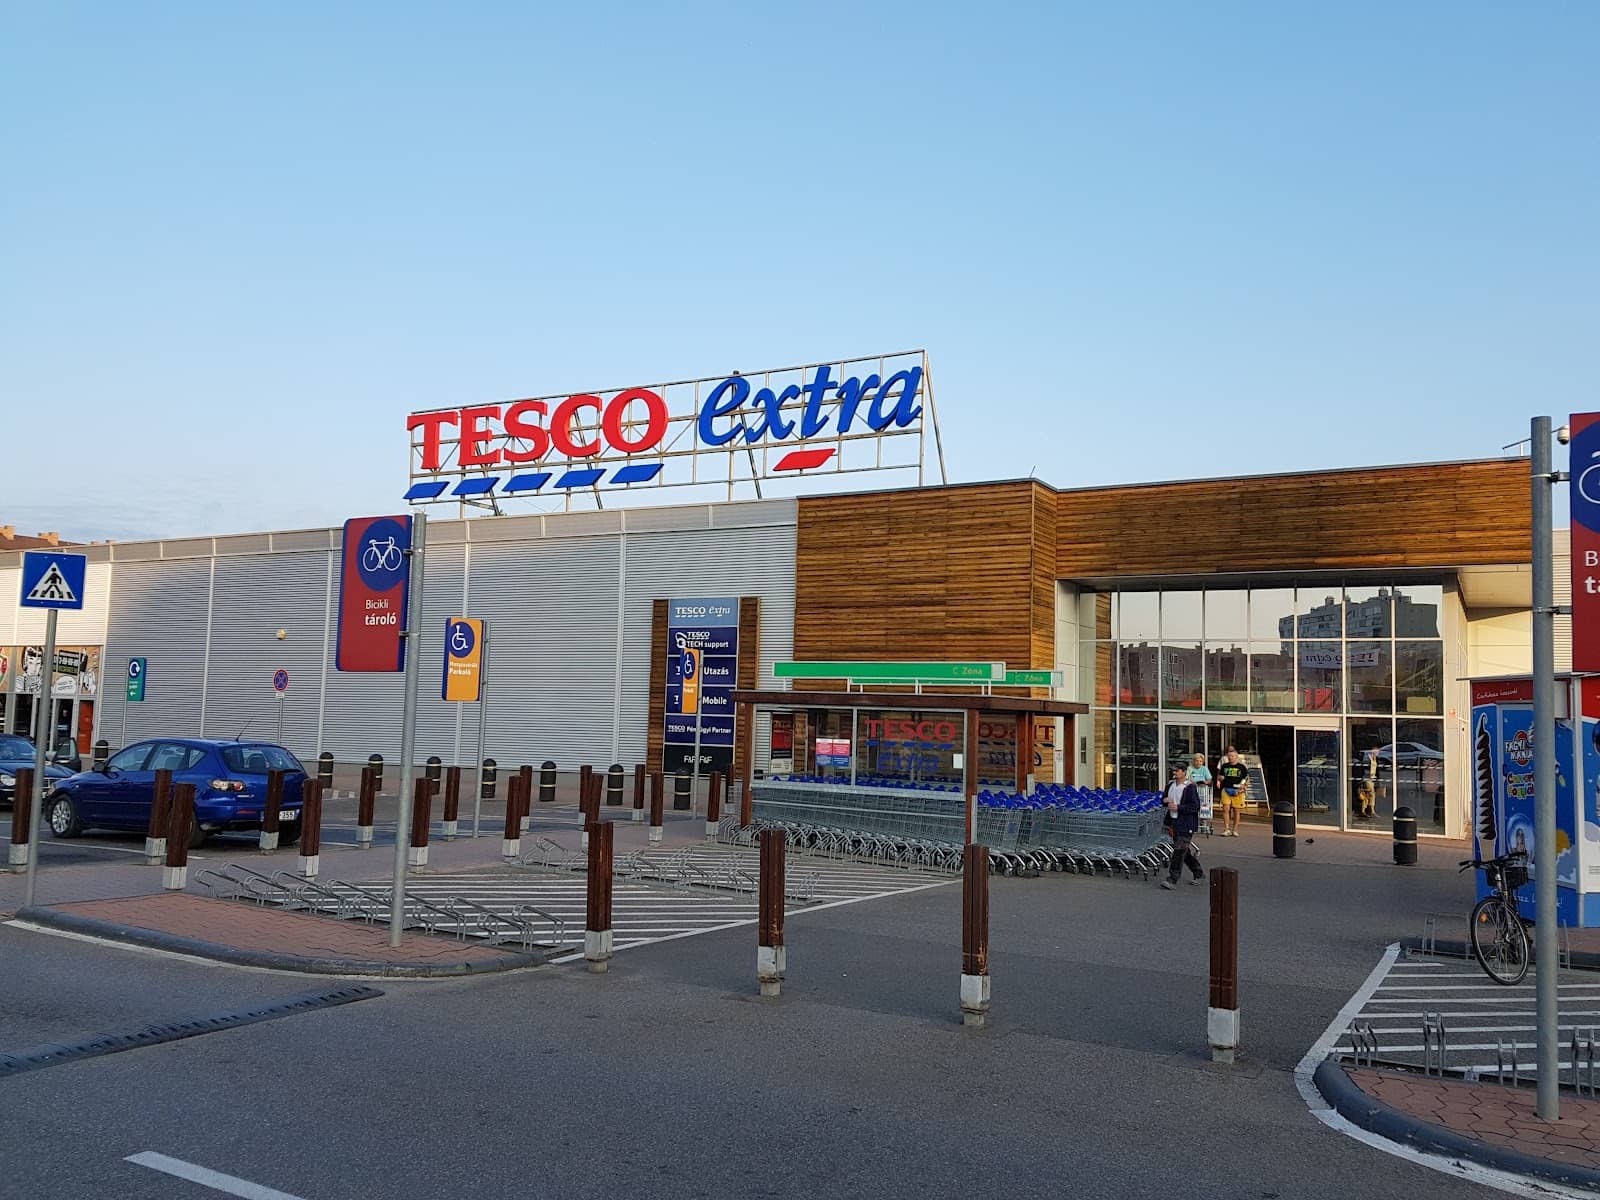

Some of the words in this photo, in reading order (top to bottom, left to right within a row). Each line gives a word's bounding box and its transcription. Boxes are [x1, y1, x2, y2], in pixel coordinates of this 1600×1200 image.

[407, 387, 669, 470] TESCO
[699, 366, 922, 446] extra
[365, 599, 389, 610] Bicikli
[674, 606, 706, 615] TESCO
[365, 612, 397, 626] tároló
[704, 641, 729, 649] support
[703, 665, 729, 675] Utazás
[702, 696, 728, 705] Mobile
[864, 719, 957, 741] TESCO
